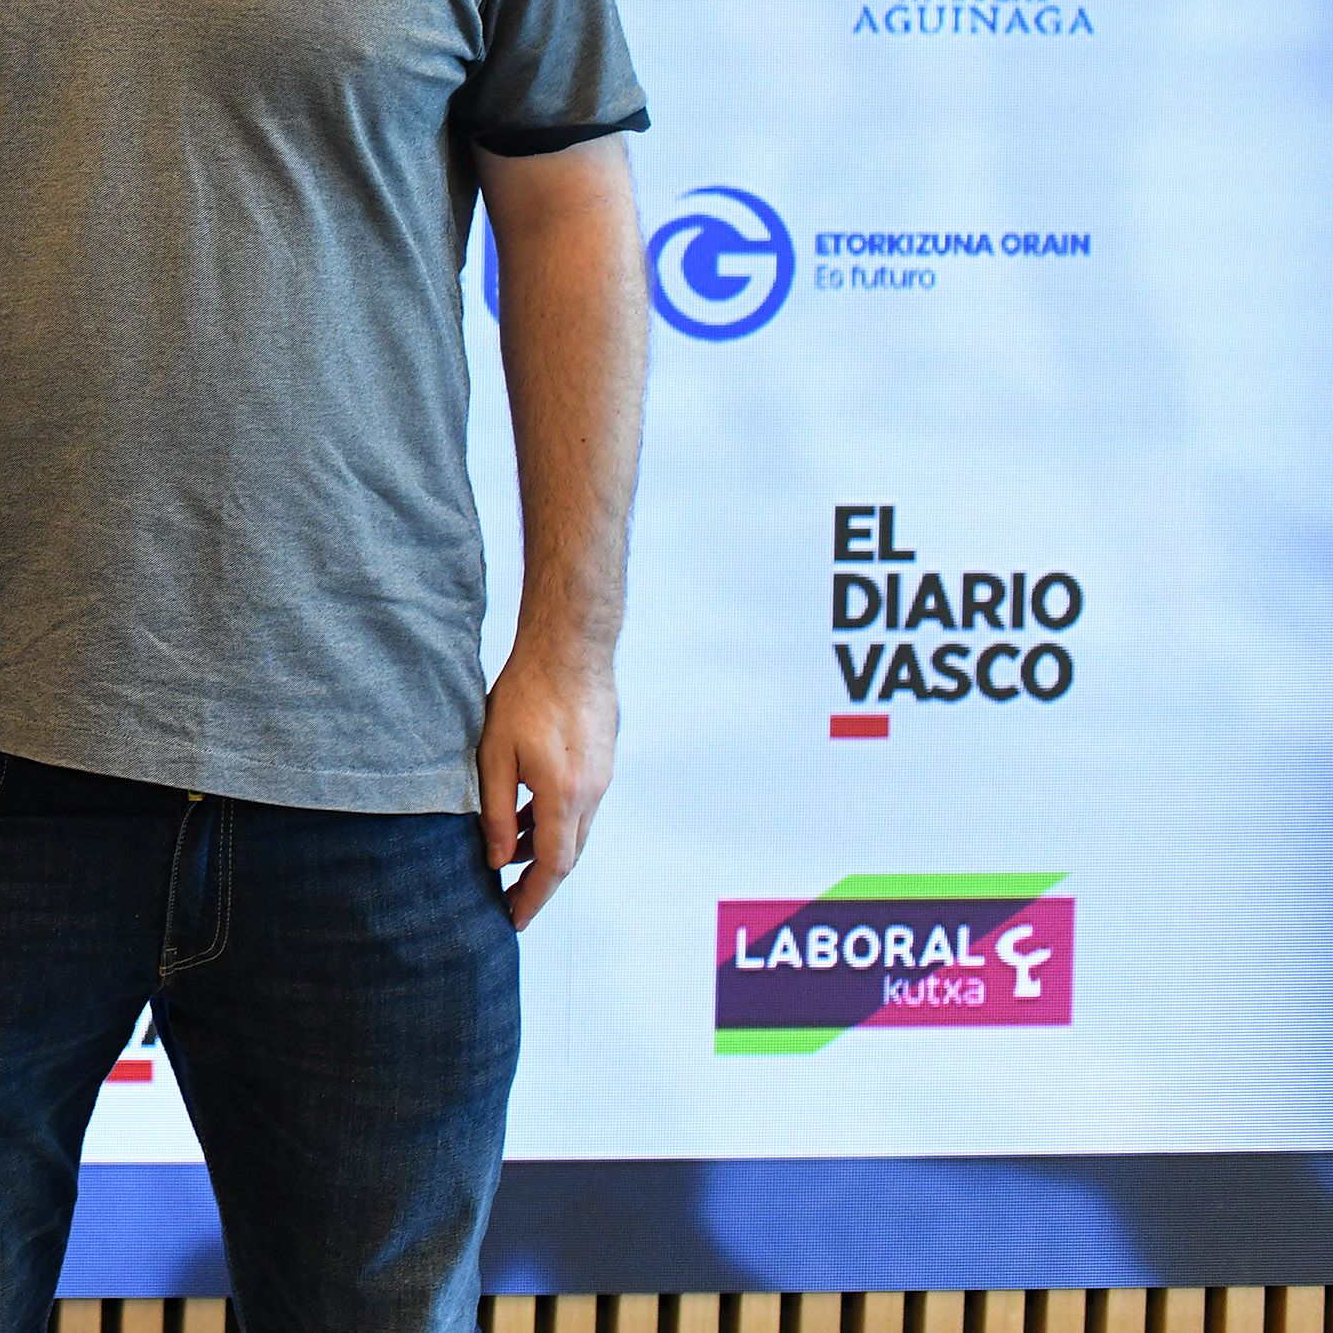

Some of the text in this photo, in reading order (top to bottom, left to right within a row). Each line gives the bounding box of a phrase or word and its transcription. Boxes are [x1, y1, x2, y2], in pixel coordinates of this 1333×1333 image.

[853, 4, 1094, 35] AGUINAGA
[815, 233, 1091, 257] ETORKIZUNA ORAIN
[851, 265, 936, 290] futuro
[834, 506, 917, 564] EL
[832, 573, 1084, 633] DIARIO
[834, 643, 1074, 704] VASCO
[736, 926, 985, 968] LABORAL
[884, 976, 985, 1005] kutxa
